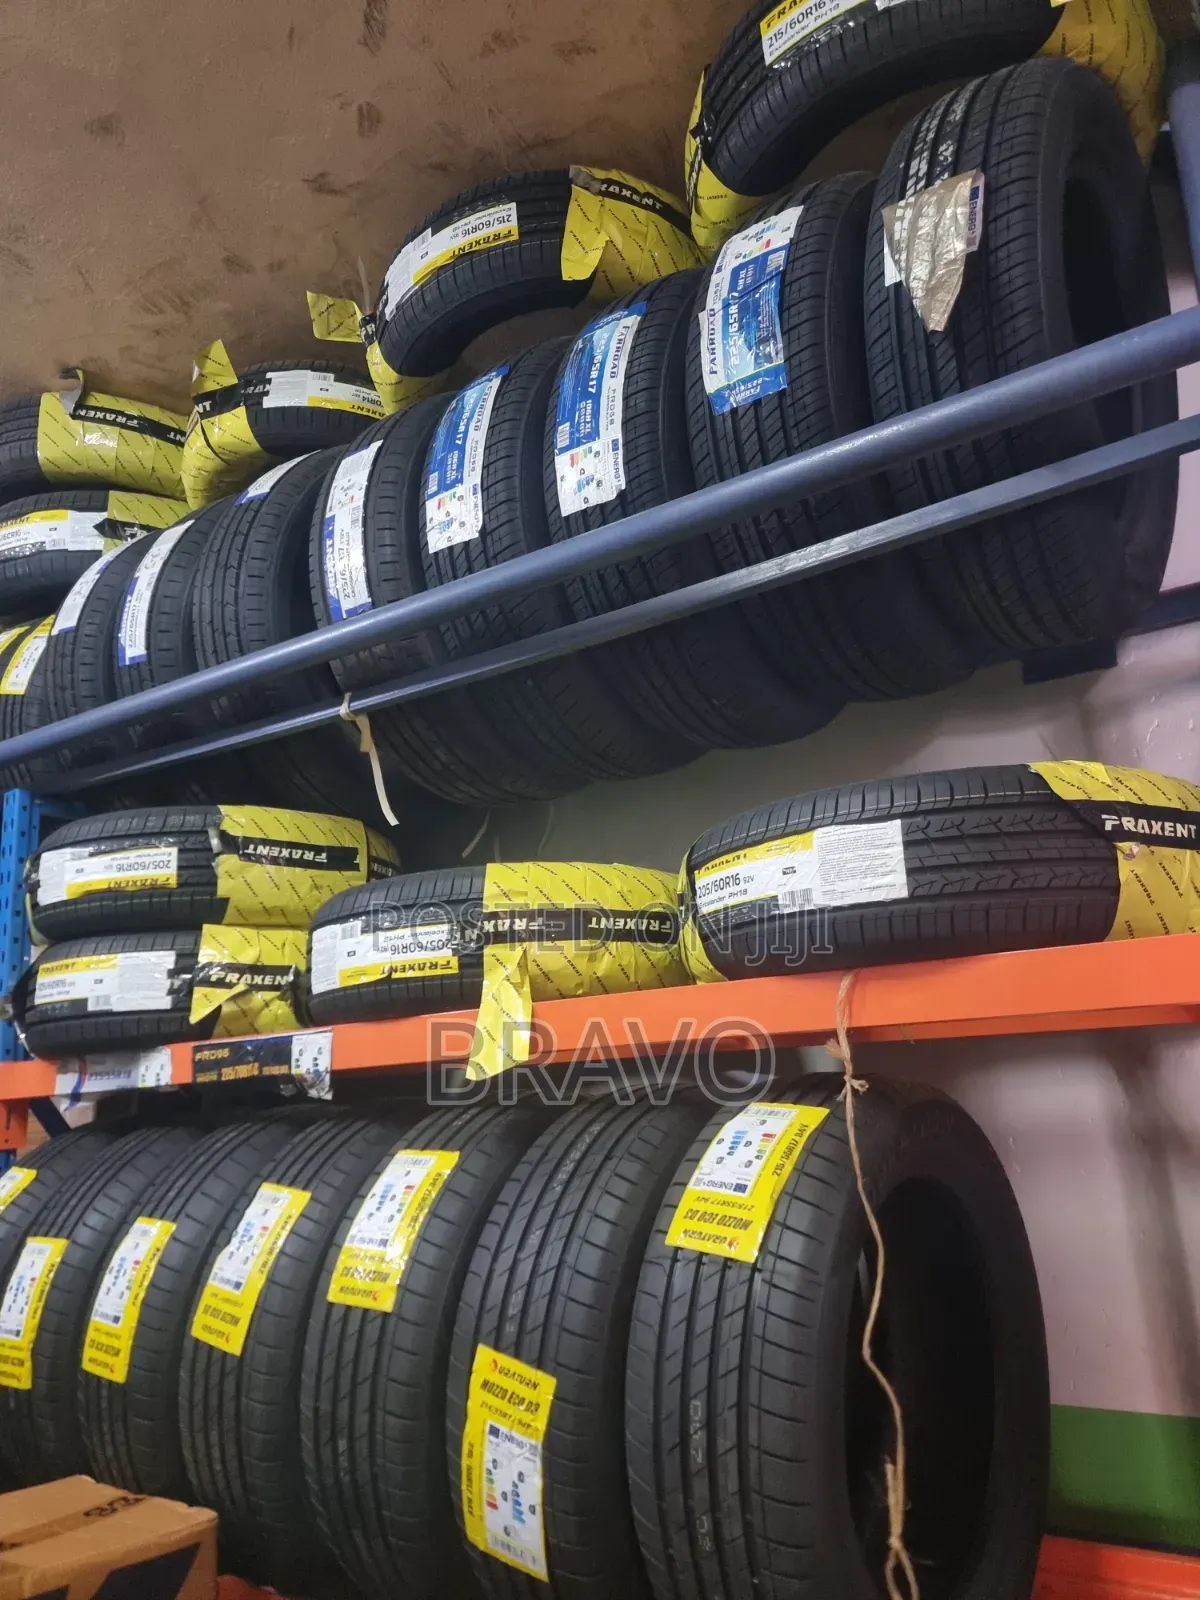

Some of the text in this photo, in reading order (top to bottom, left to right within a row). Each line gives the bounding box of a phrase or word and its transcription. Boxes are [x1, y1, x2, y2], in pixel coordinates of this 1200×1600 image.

[766, 0, 807, 28] FRA
[768, 0, 827, 49] 215/60R16
[460, 213, 513, 239] 215/60R16
[449, 229, 515, 260] FRAXENT
[587, 332, 611, 394] 225/65R17
[609, 325, 631, 379] FARROAD
[76, 408, 140, 428] FRAXEN
[349, 404, 387, 421] AXENT
[612, 452, 622, 480] ENERG
[1101, 814, 1197, 840] FRAXENT
[115, 859, 172, 873] 205/60R16
[244, 844, 328, 863] FRAXENT
[697, 872, 756, 899] 205/60R16 92V
[727, 888, 748, 900] PH18
[587, 916, 672, 932] FRAXENT
[390, 939, 454, 956] 205/60R16
[209, 972, 288, 986] FRAXEN
[380, 959, 453, 975] FRAXENT
[772, 1133, 801, 1178] 215/55R17
[704, 1179, 735, 1191] ENERG
[682, 1207, 754, 1232] MOZZO ECO D3
[480, 1378, 509, 1401] MOZZO
[507, 1391, 527, 1409] ECO
